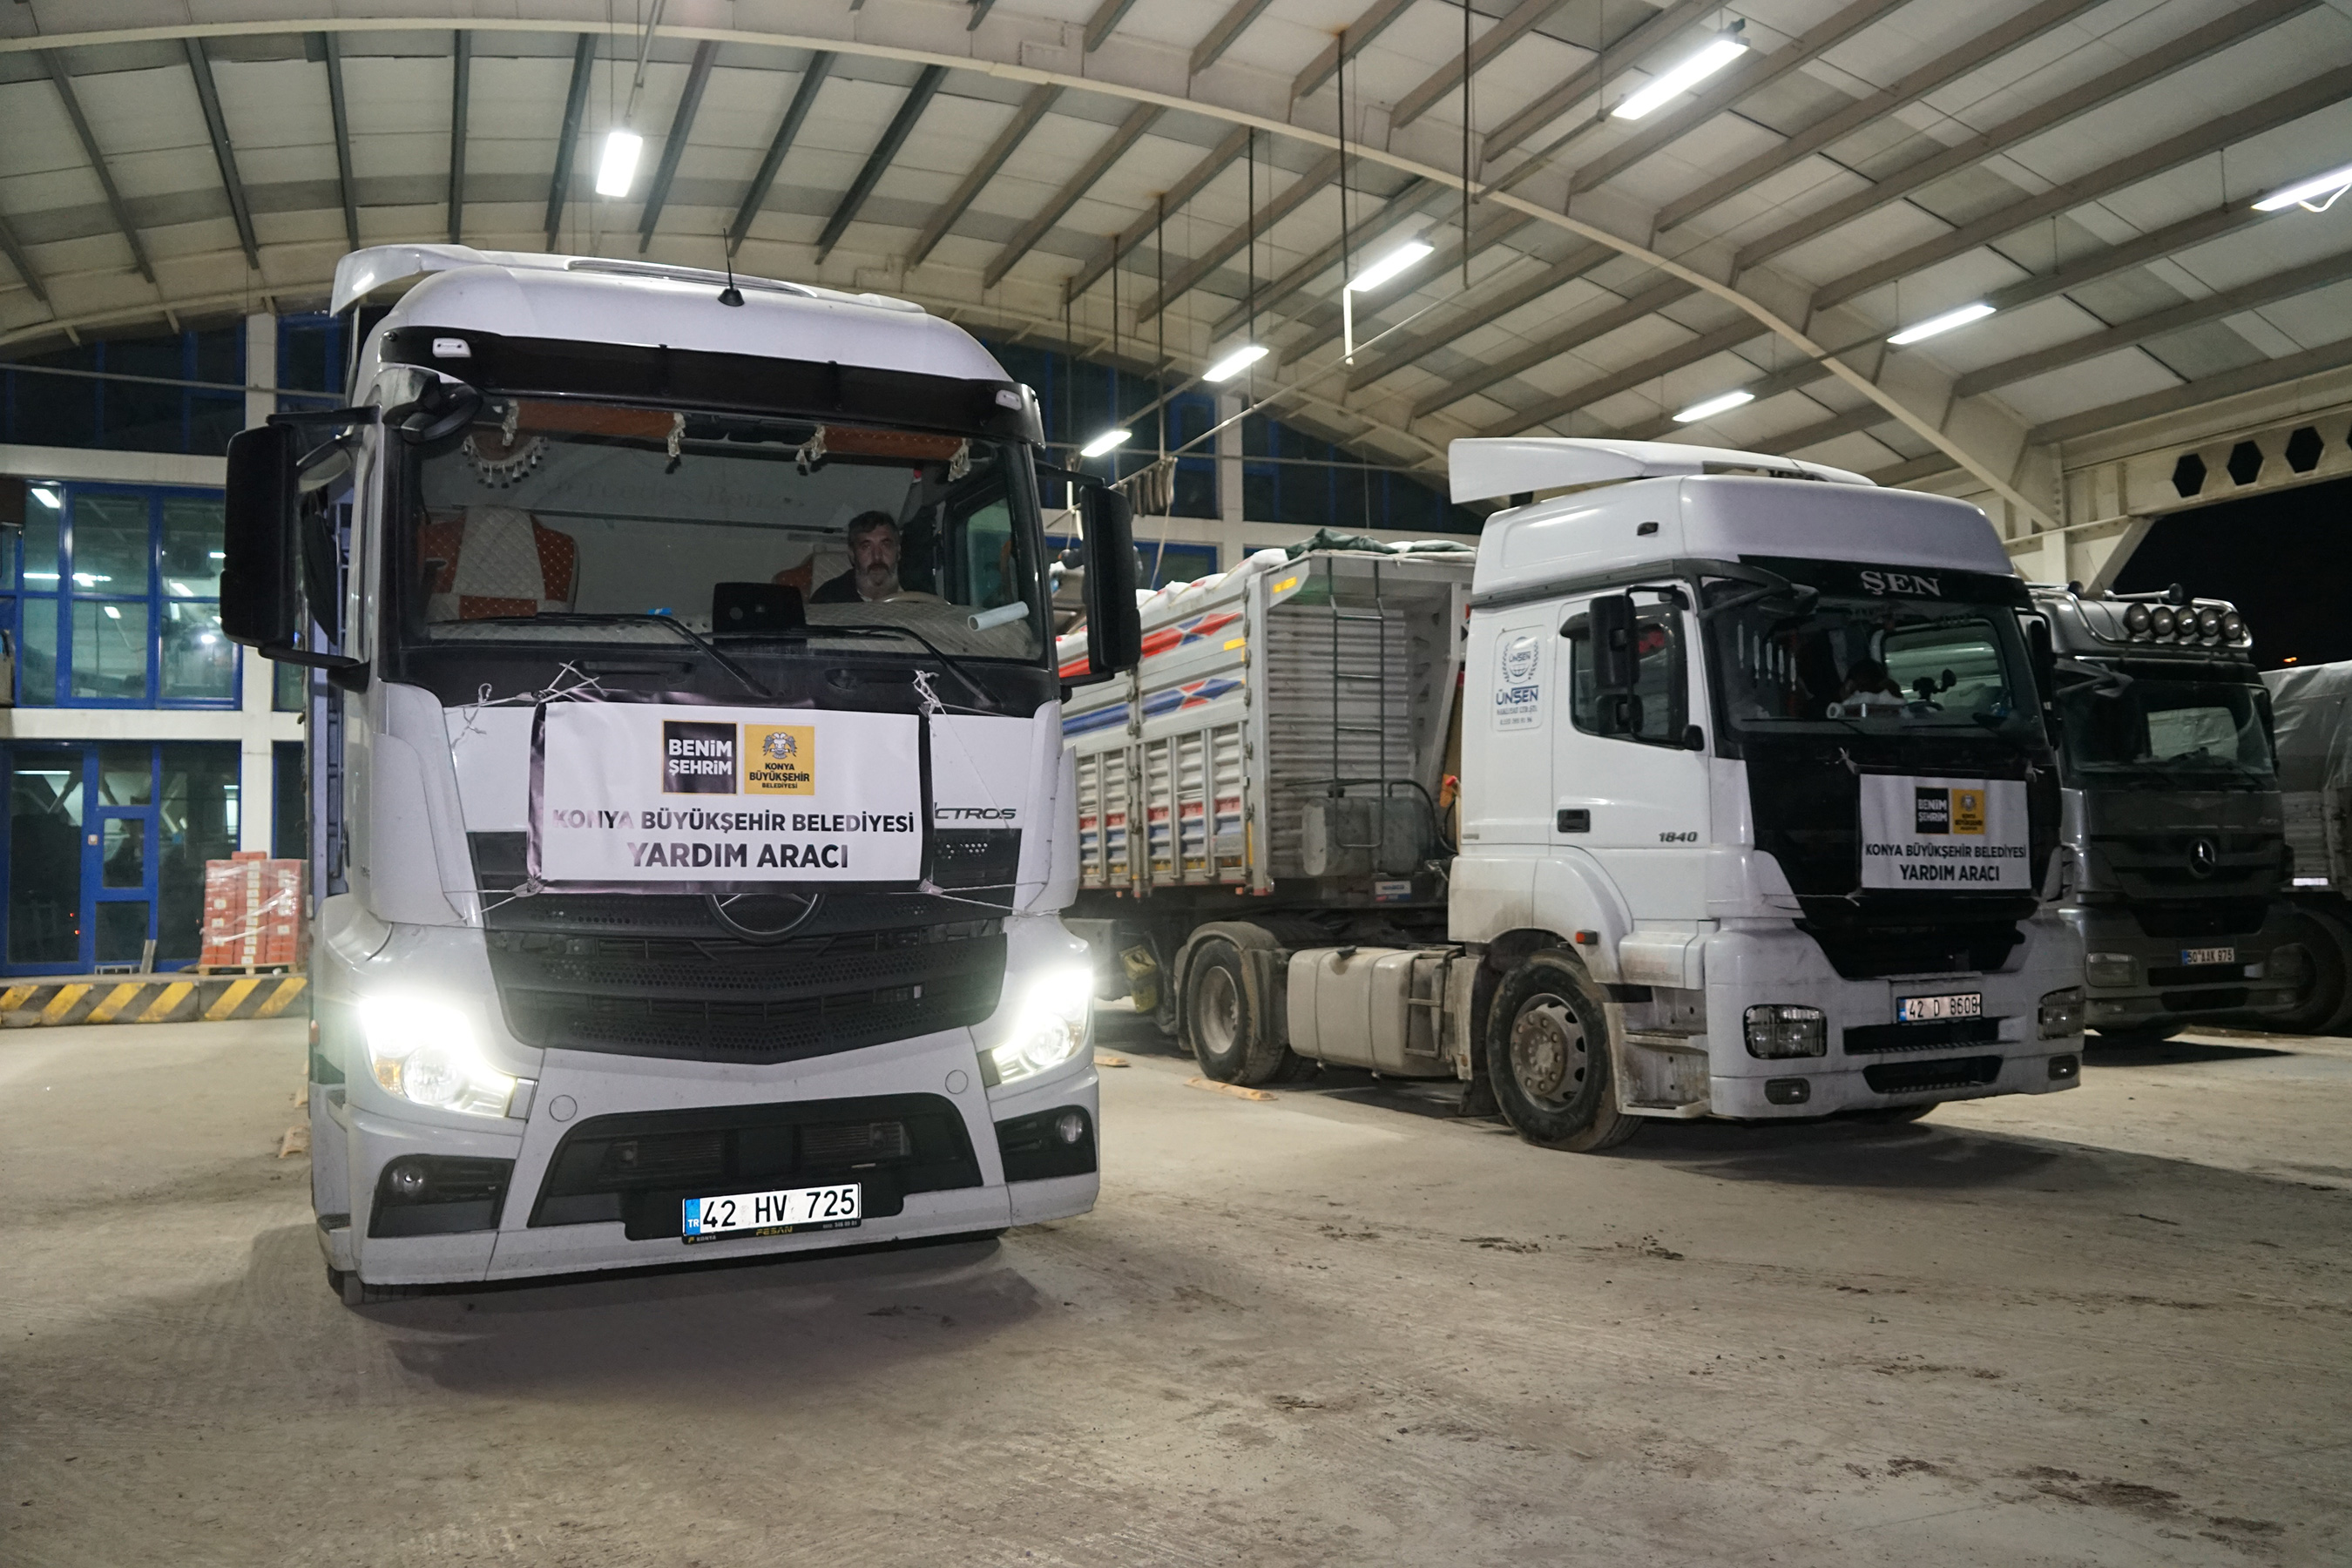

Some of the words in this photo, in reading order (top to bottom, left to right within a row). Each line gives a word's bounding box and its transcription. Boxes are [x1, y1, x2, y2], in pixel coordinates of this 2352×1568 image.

[1860, 570, 1942, 597] ŞEN
[765, 762, 794, 771] KONYA
[749, 770, 810, 782] BÜYÜKŞEHİR
[934, 802, 1017, 820] CTROS
[553, 809, 635, 829] KONYA
[641, 807, 786, 834] BÜYÜKŞEHİR
[792, 810, 914, 833] BELEDİYESİ
[1659, 831, 1698, 842] 1840
[626, 841, 747, 868] YARDIM
[756, 843, 848, 868] ARACI
[1865, 843, 1903, 856] KONYA
[1906, 842, 1971, 859] BÜYÜKŞEHİR
[1976, 844, 2026, 858] BELEDİYESİ
[1900, 864, 1955, 881] YARDIM
[1958, 865, 2000, 882] ARACI
[1909, 1001, 1923, 1018] 42
[1934, 999, 1940, 1017] D
[1950, 997, 1978, 1015] 8608
[703, 1200, 736, 1227] 42
[755, 1194, 787, 1223] HV
[806, 1188, 855, 1219] 725
[688, 1219, 700, 1228] TR
